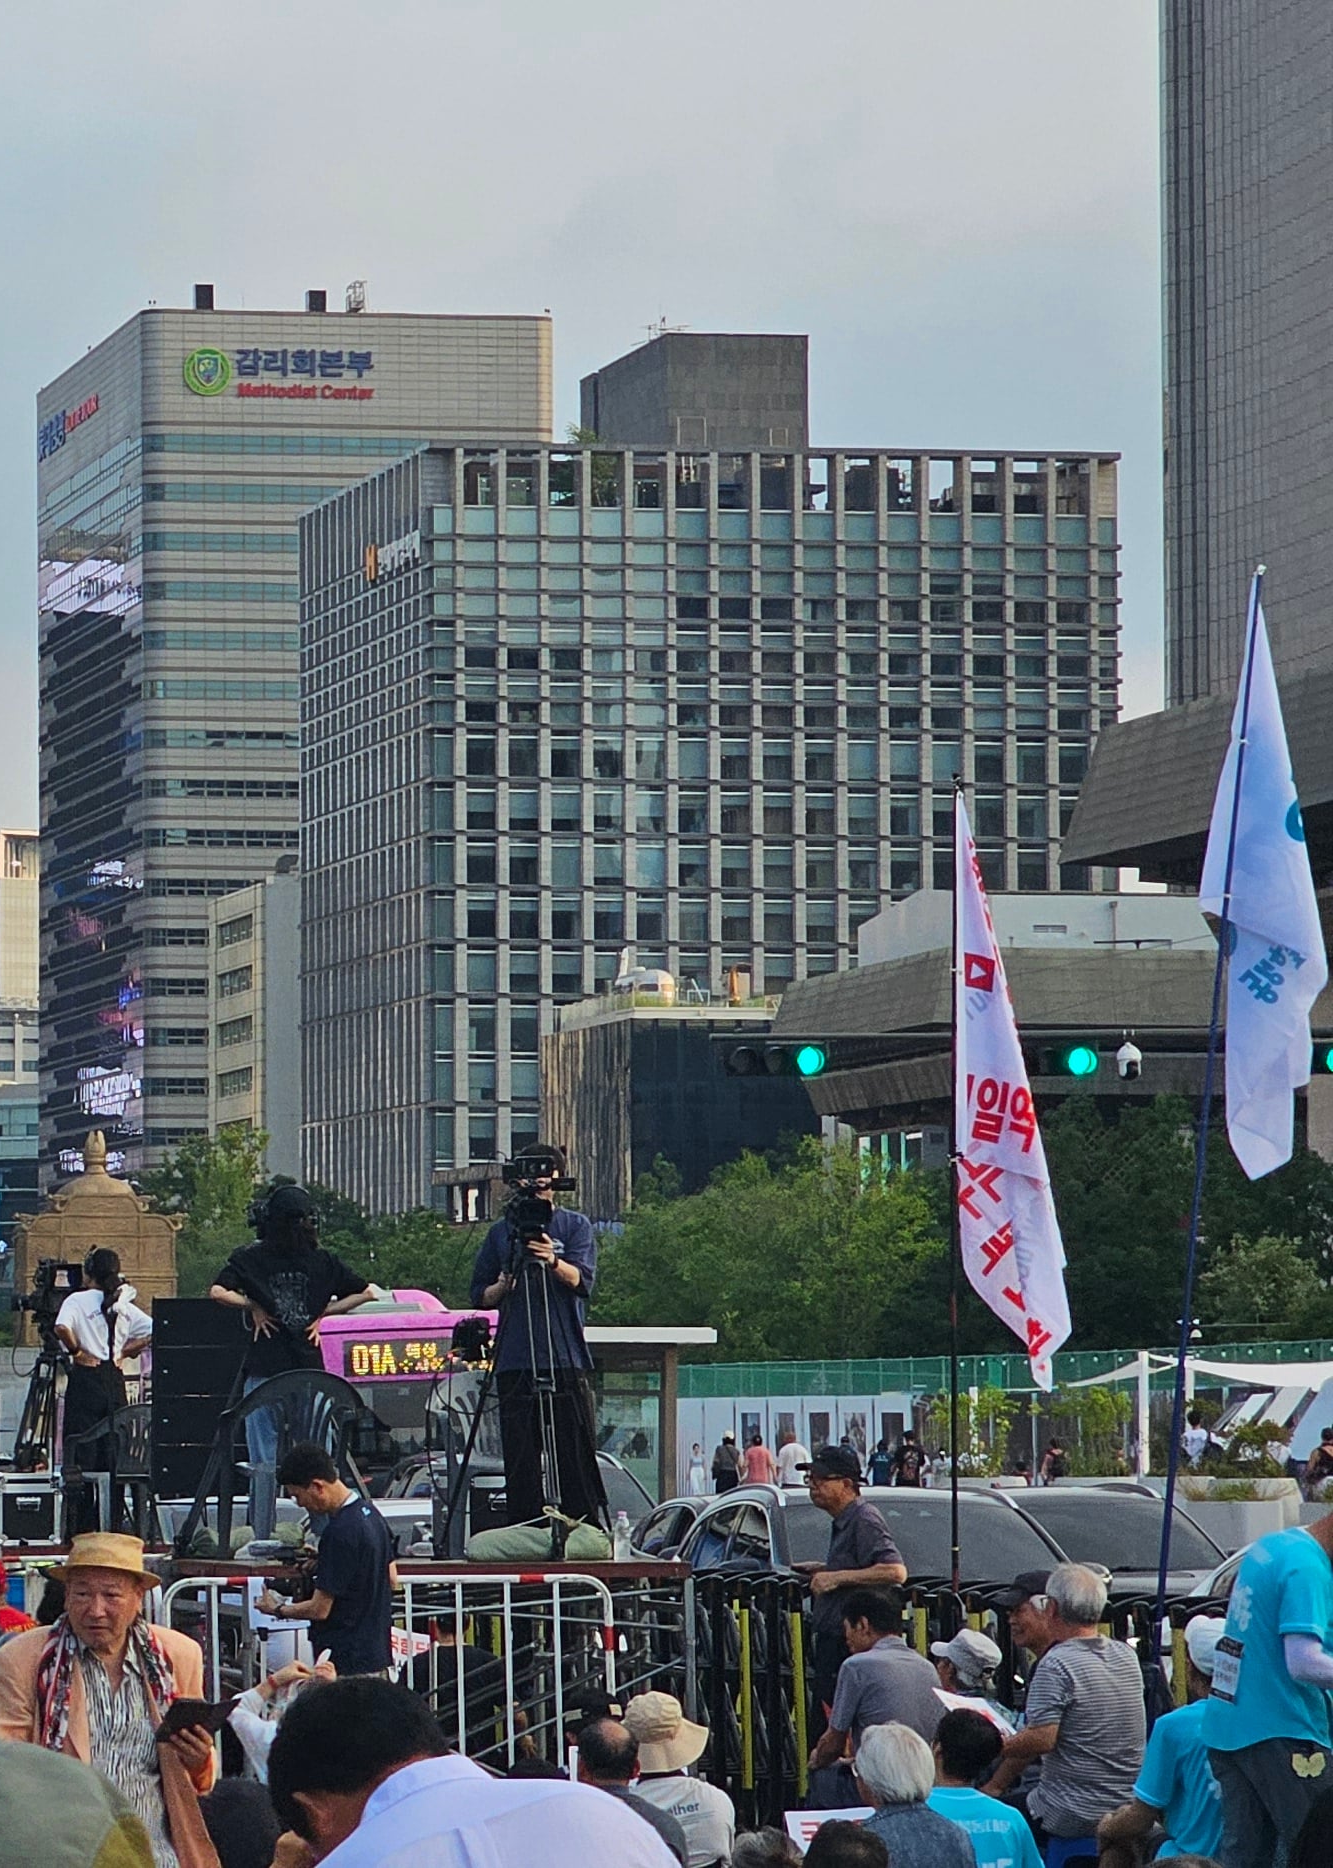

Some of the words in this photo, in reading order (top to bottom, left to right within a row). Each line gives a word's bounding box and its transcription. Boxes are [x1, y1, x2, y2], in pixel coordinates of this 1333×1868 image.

[235, 347, 374, 378] 감리회본부
[237, 382, 317, 399] Methodist
[321, 384, 375, 400] Center
[352, 1343, 397, 1375] 01A
